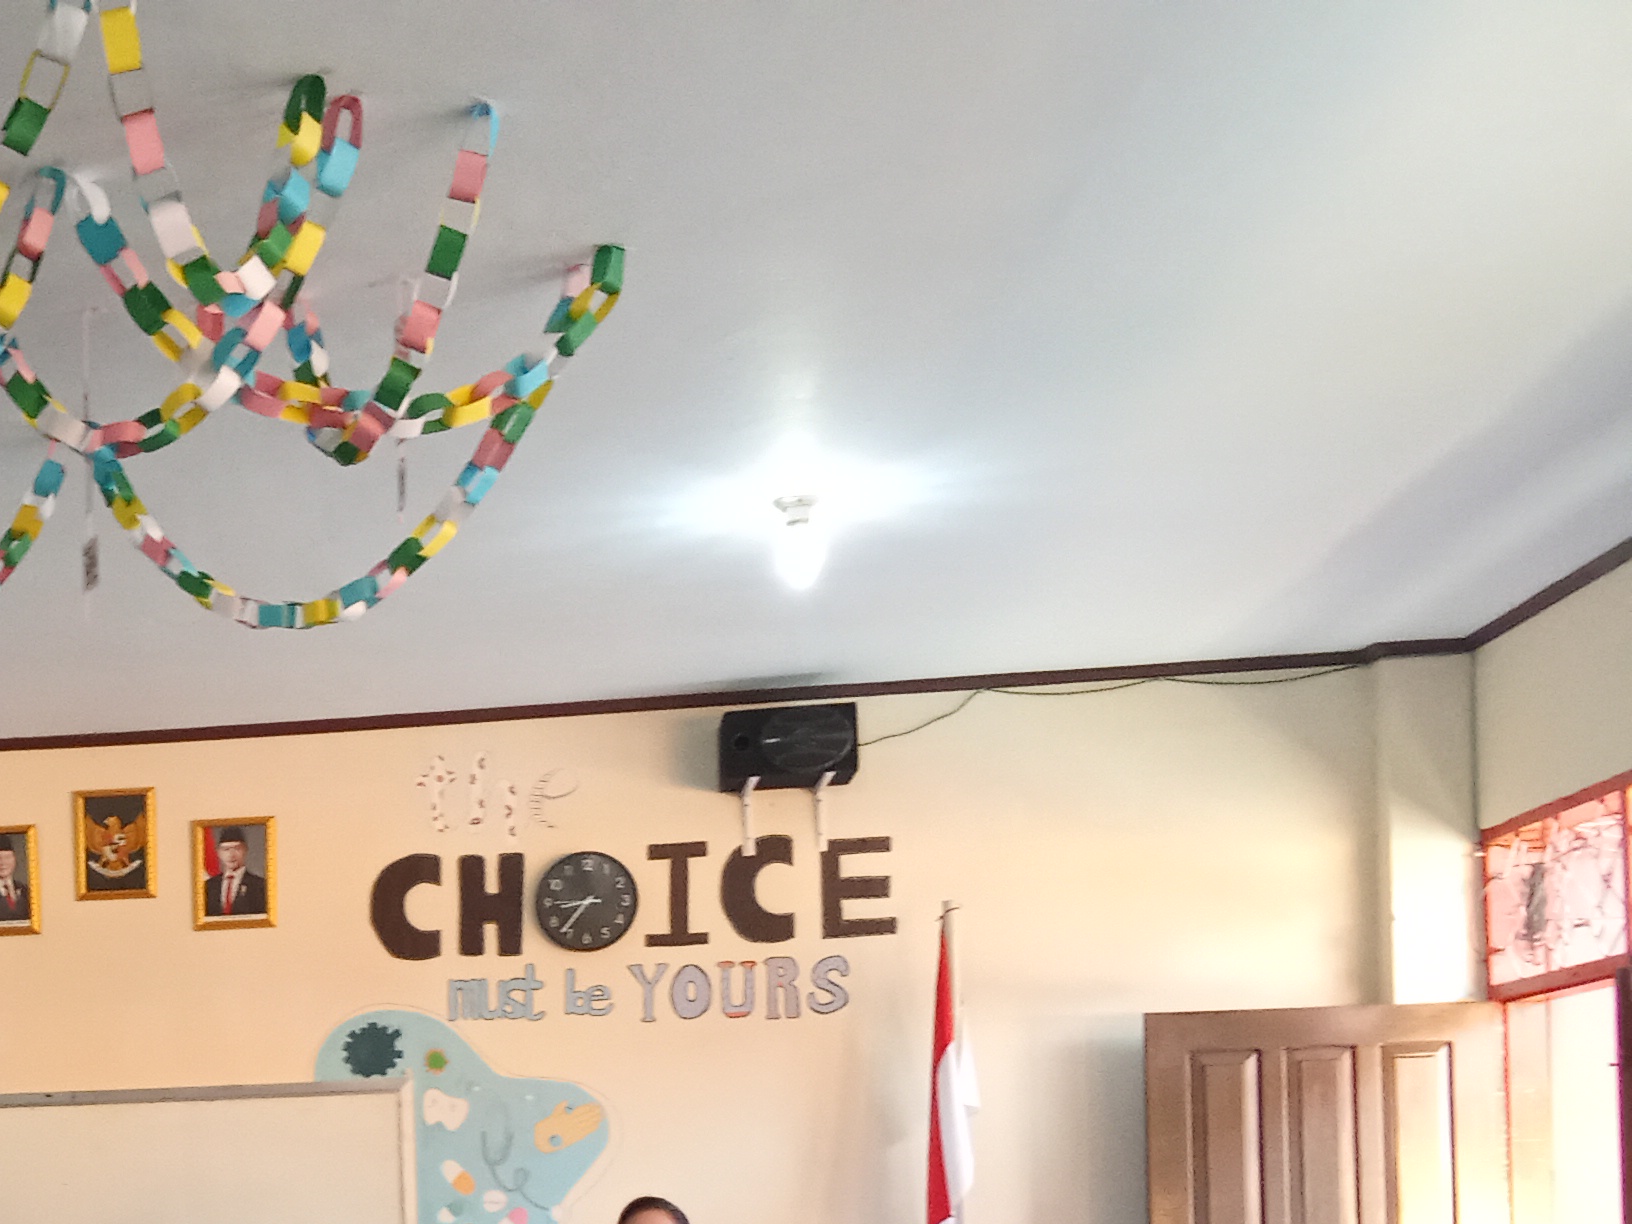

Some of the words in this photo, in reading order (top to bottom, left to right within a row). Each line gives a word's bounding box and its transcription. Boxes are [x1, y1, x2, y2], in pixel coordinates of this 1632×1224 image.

[415, 752, 580, 848] the
[448, 963, 546, 1021] must
[565, 968, 614, 1016] be
[626, 955, 850, 1023] YOURS
